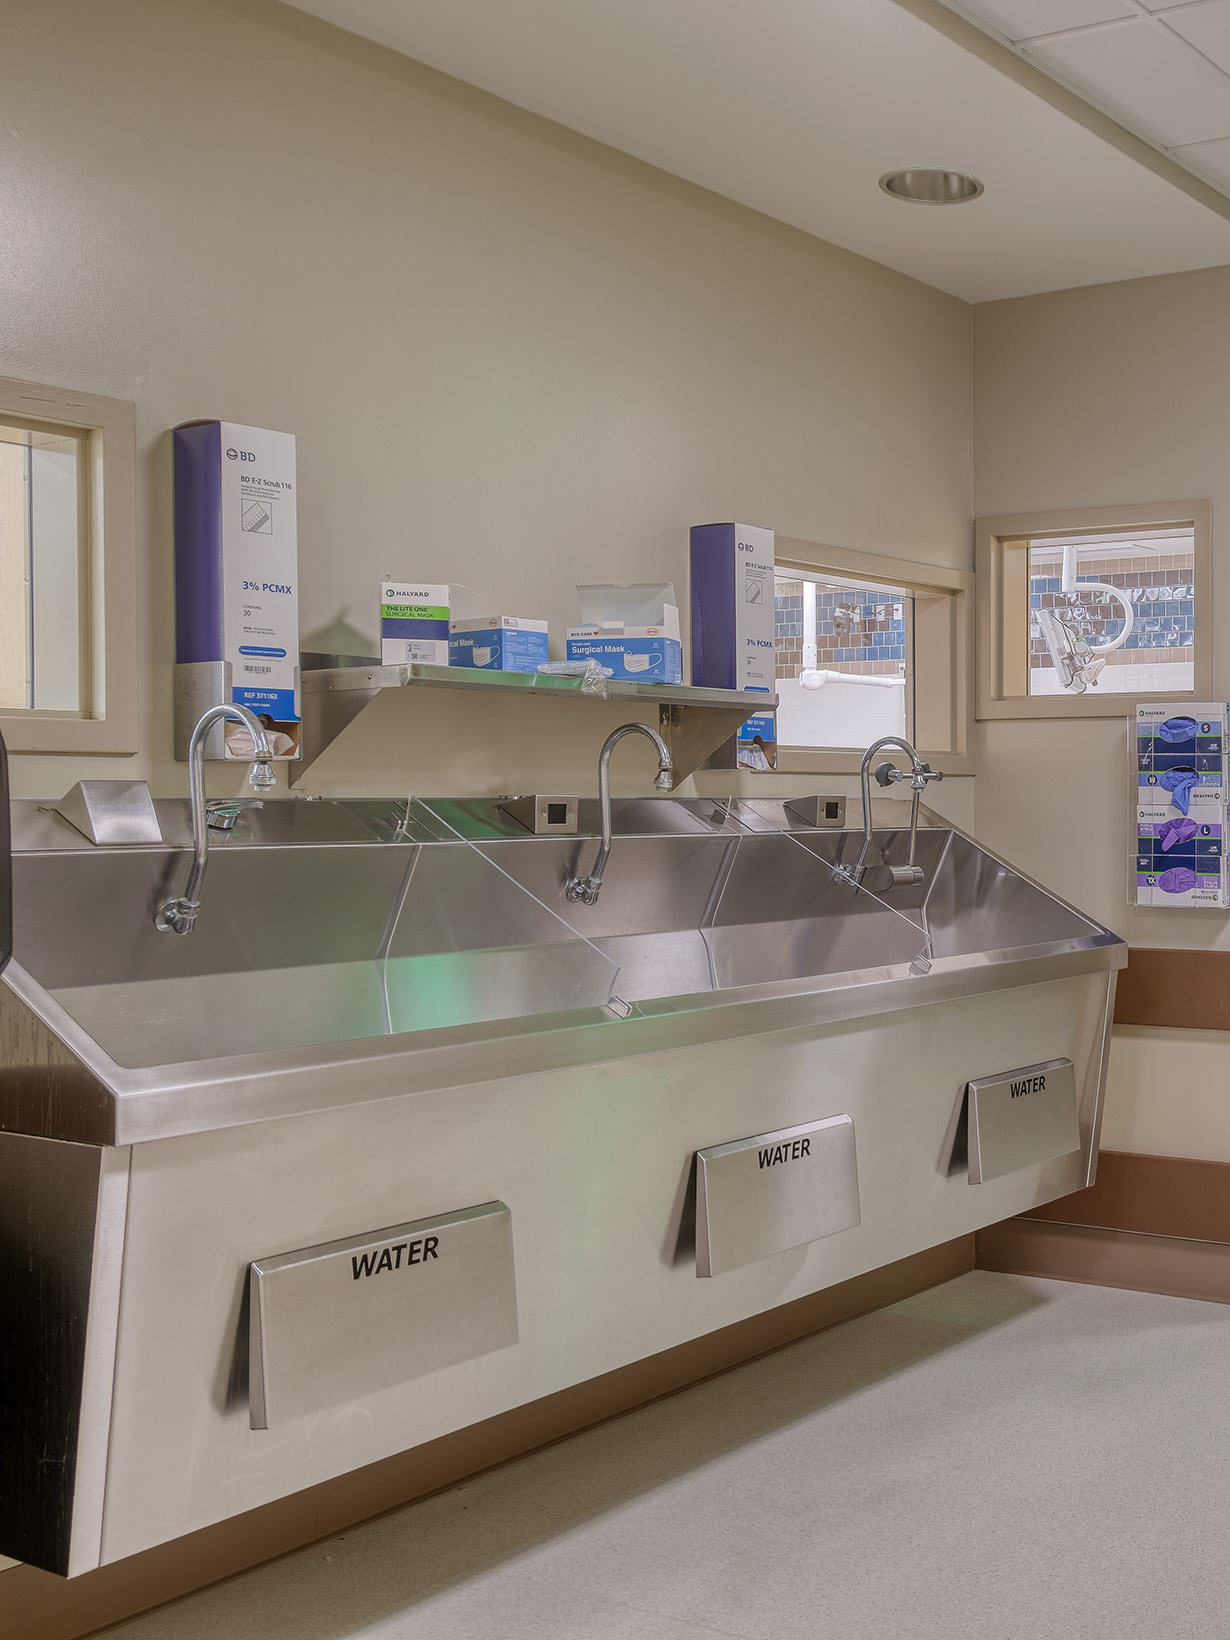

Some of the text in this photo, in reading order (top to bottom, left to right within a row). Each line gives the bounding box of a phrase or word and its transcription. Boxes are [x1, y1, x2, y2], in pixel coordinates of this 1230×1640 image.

[240, 451, 256, 462] BD
[252, 477, 262, 485] E-Z
[263, 480, 280, 488] Scrub
[282, 482, 292, 490] 116
[745, 544, 754, 552] BD
[242, 580, 292, 594] 3% PCMX
[571, 646, 603, 655] Surgical
[605, 645, 625, 653] Mask
[757, 640, 772, 648] PCMX
[1010, 1075, 1046, 1099] WATER
[757, 1137, 811, 1169] WATER
[351, 1235, 440, 1281] WATER
